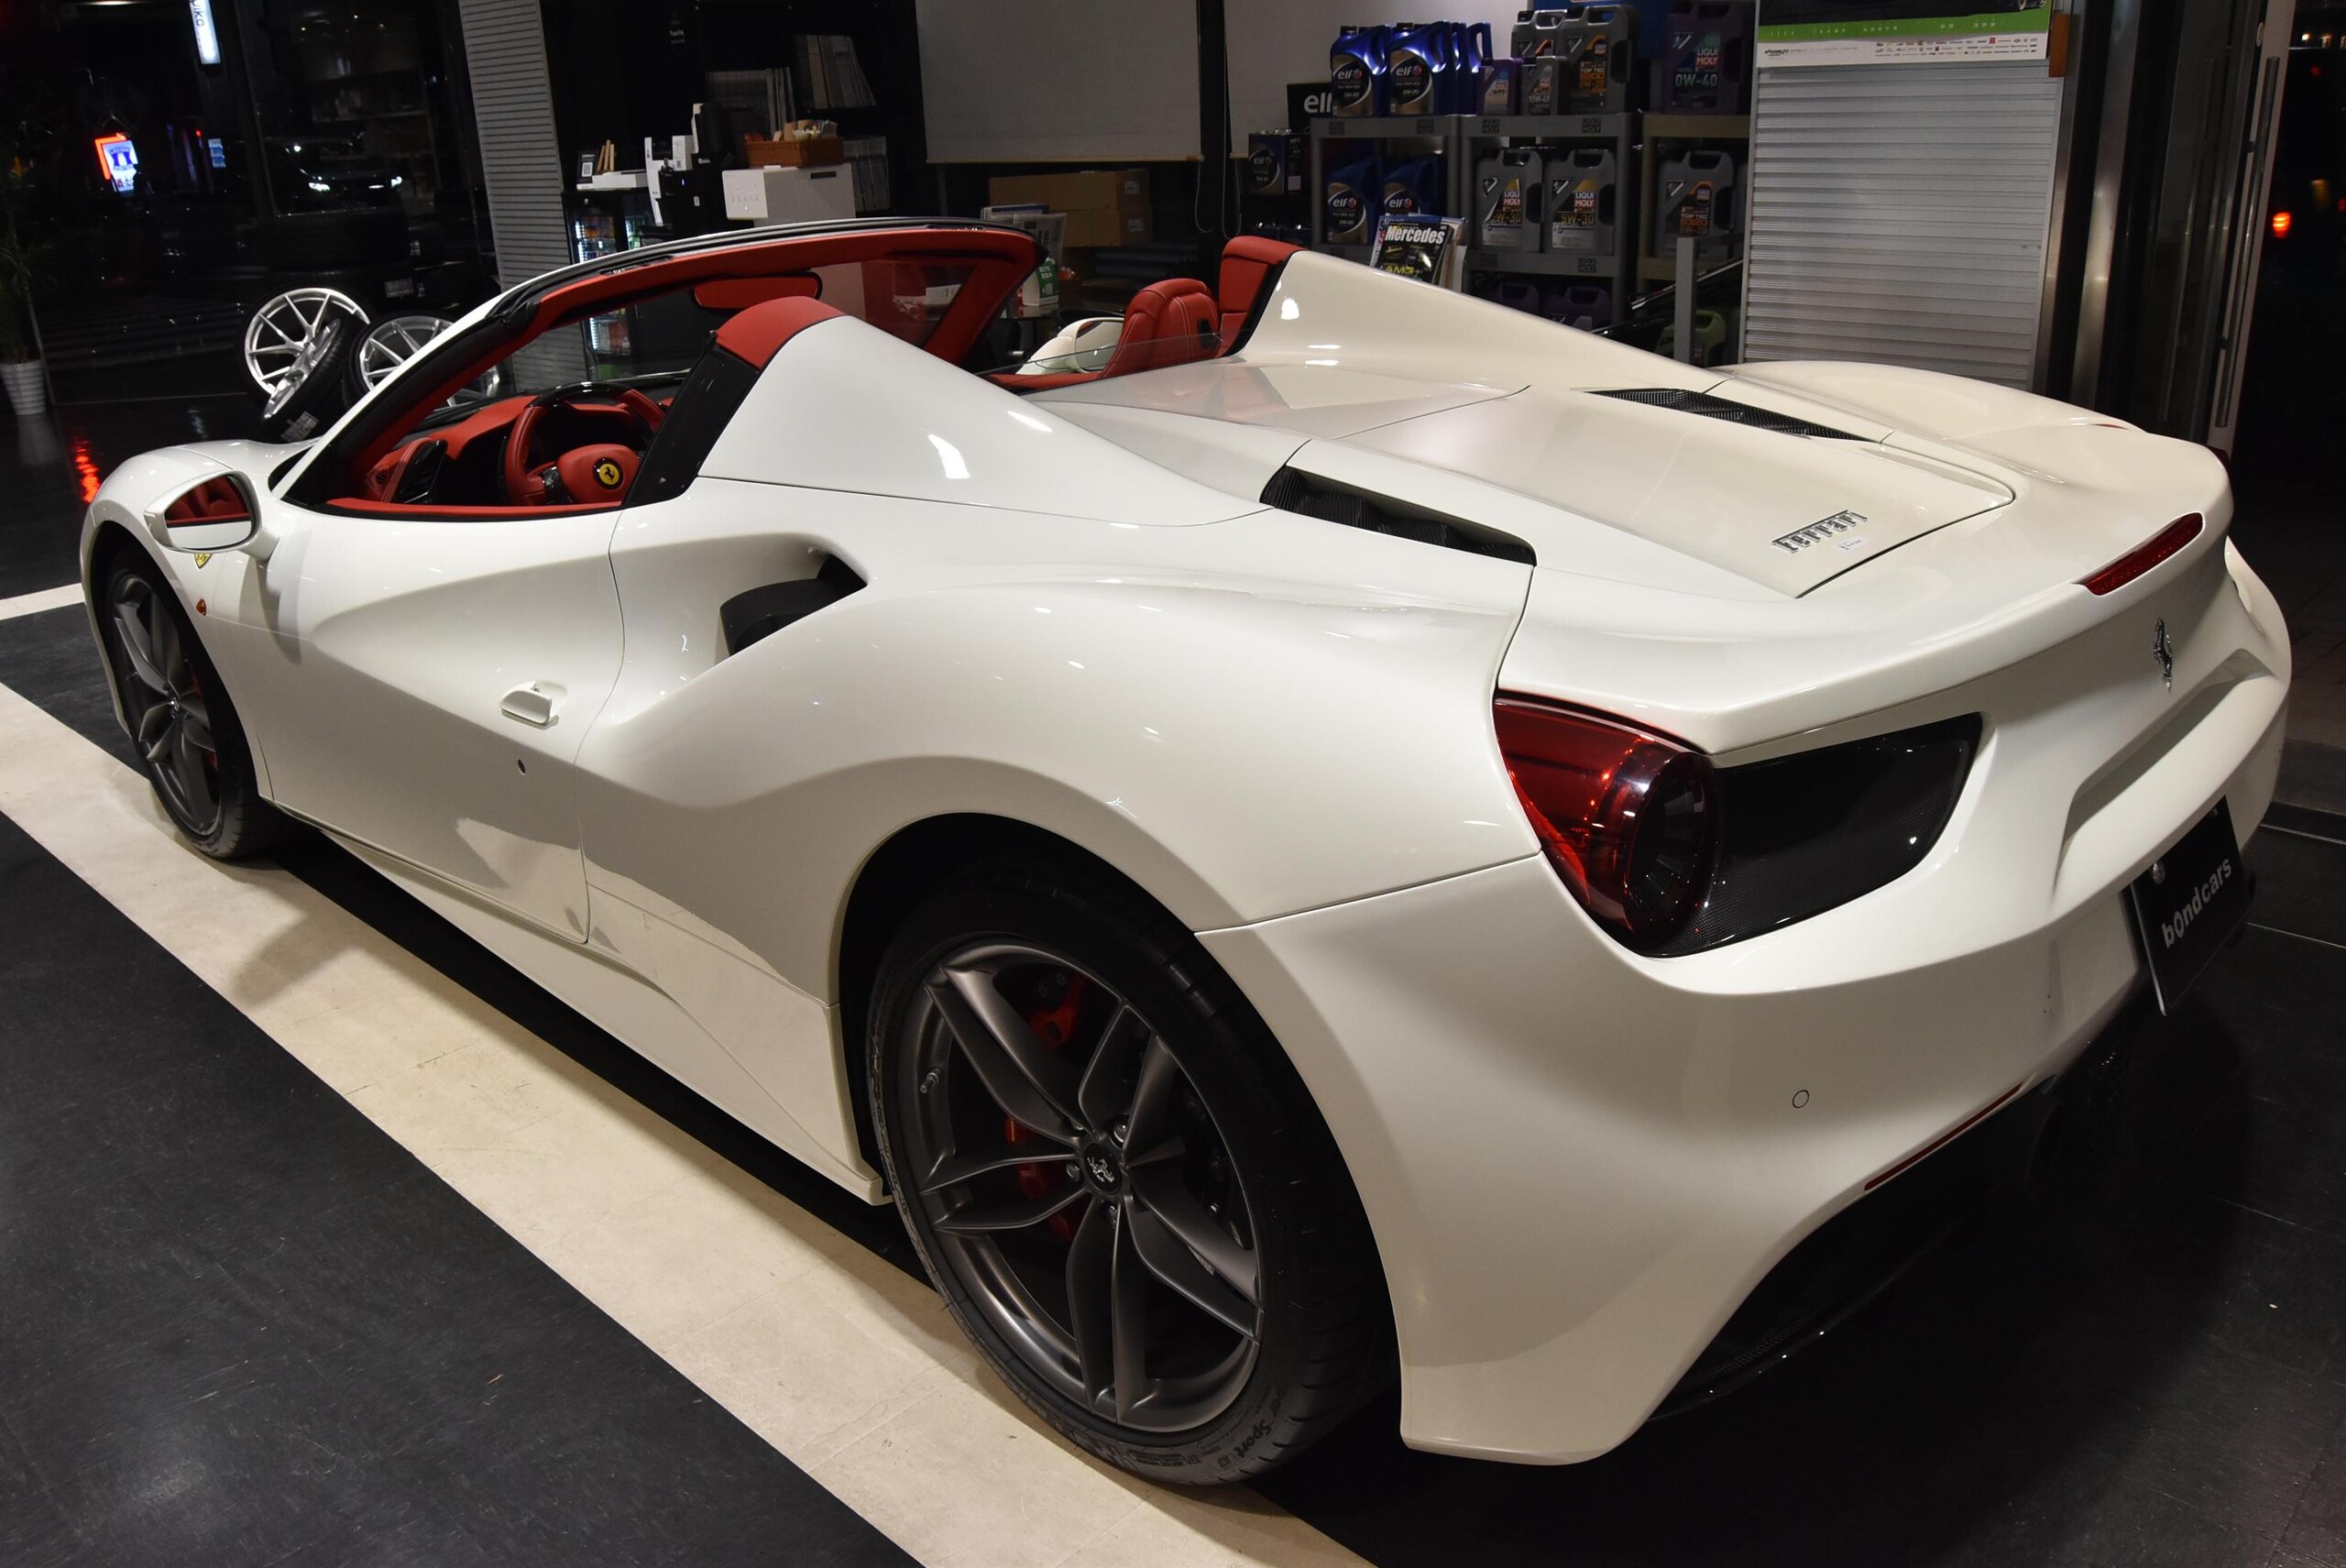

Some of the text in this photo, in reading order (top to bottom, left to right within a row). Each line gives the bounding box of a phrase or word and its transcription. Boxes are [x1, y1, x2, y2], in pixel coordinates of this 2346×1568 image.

[1696, 57, 1718, 65] MOLY
[1337, 69, 1354, 80] elf
[1396, 66, 1412, 77] elf
[1675, 73, 1718, 87] 0W-40
[1253, 156, 1266, 165] elf
[1333, 198, 1348, 208] elf
[1388, 198, 1404, 208] elf
[1504, 198, 1520, 206] MOLY
[1574, 199, 1595, 207] MOLY
[1561, 214, 1595, 225] 5W-30
[1385, 225, 1445, 245] Mercedes
[1771, 509, 1868, 554] Ferrari
[1233, 1419, 1273, 1459] Sport
